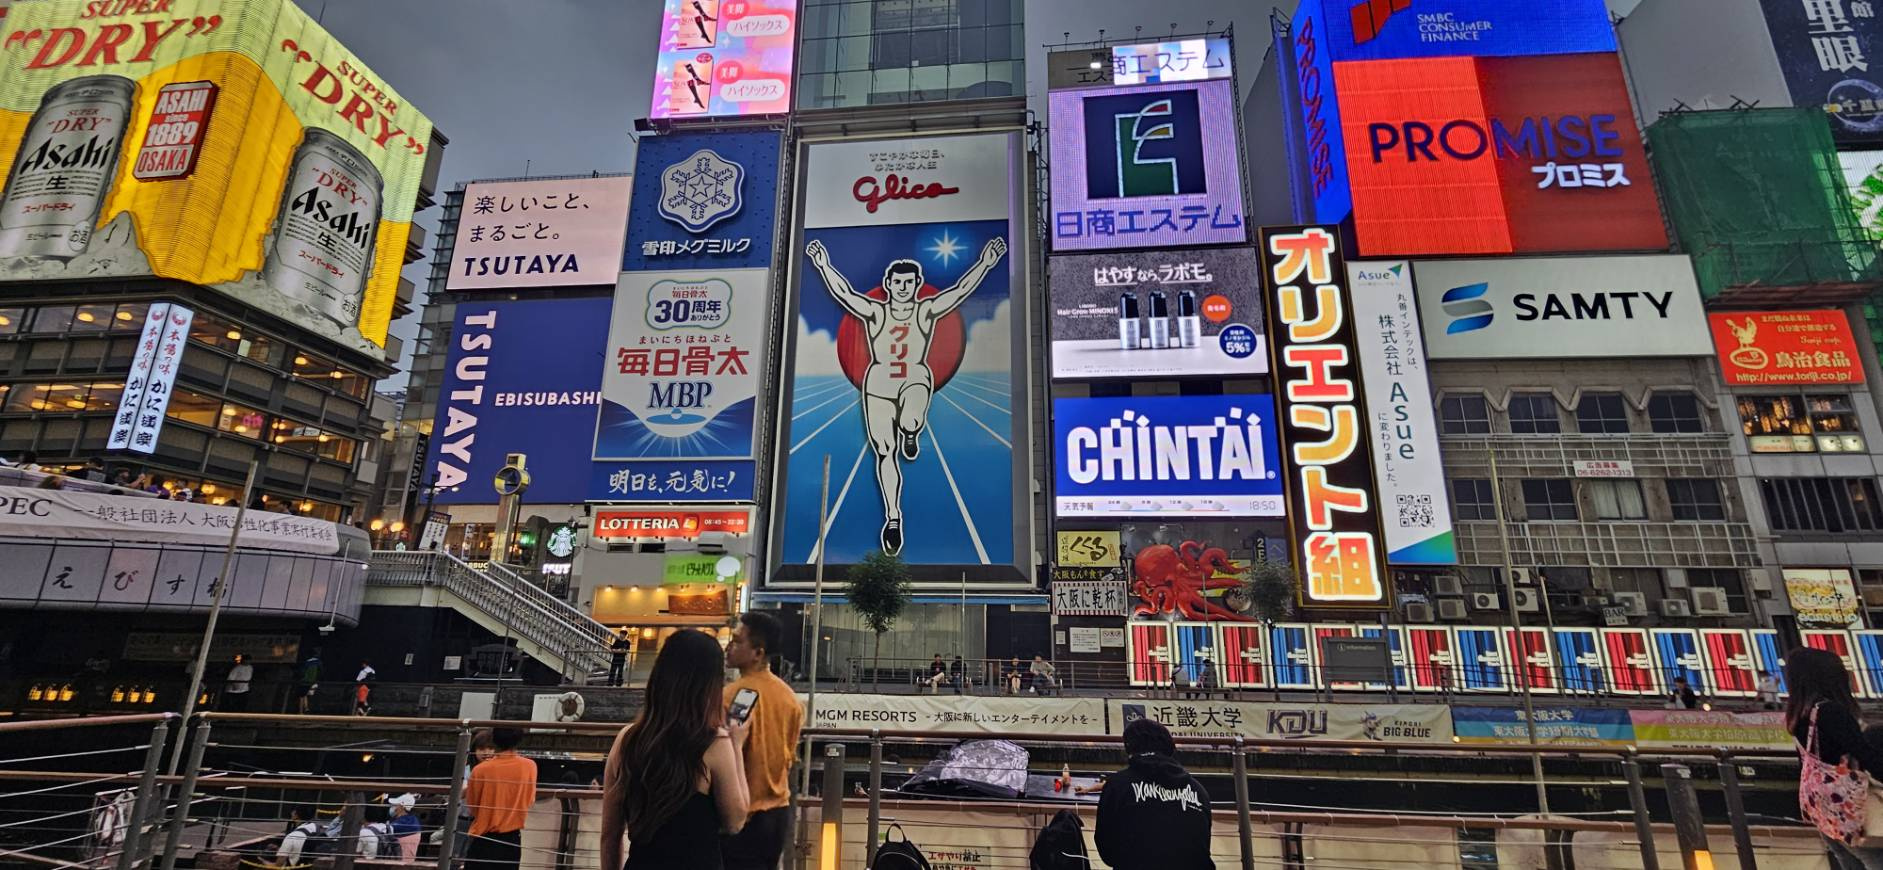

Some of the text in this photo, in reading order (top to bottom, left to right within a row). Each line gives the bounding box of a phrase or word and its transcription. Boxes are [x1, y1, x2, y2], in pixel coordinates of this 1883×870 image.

[734, 20, 783, 32] ハイソックス
[1417, 13, 1454, 24] SMBC
[1418, 21, 1493, 33] CONSUMER
[1421, 31, 1481, 42] FINANCE
[337, 60, 398, 116] SUPER
[727, 84, 778, 97] ハイソックス
[155, 87, 207, 114] ASAHI
[1297, 16, 1334, 198] PROMISE
[67, 109, 99, 117] SUPER
[165, 114, 188, 123] since
[144, 121, 197, 147] 1889
[1368, 114, 1626, 164] PROMISE
[20, 135, 114, 175] Asahi
[138, 144, 190, 172] OSAKA
[46, 175, 69, 190] 生
[329, 167, 358, 190] SUPER
[1531, 162, 1632, 189] プロミス
[473, 193, 591, 216] 楽しいこと、
[852, 174, 960, 213] Glico
[22, 202, 76, 214] スーパードライ
[291, 186, 371, 250] Asahi
[469, 222, 560, 243] まるごと。
[1056, 204, 1242, 239] 日商エステム
[316, 231, 337, 252] 生
[641, 238, 751, 256] 雪印メグミルク
[298, 250, 345, 278] スーパードライ
[464, 254, 580, 277] TSUTAYA
[1358, 270, 1391, 280] Asue
[672, 290, 708, 299] 毎日骨太
[1513, 291, 1673, 321] SAMTY
[654, 299, 722, 323] 30周年
[690, 314, 721, 322] ありがとう
[136, 326, 159, 373] 本場の味
[638, 334, 733, 345] まいにちほねぶと
[888, 322, 911, 379] グリコ
[1378, 314, 1403, 376] 株式会社
[158, 328, 181, 376] 本場の味
[617, 346, 750, 377] 毎日骨太
[434, 310, 497, 492] TSUTAYA
[494, 391, 600, 406] EBISUBASHI
[648, 382, 713, 408] MBP
[112, 377, 144, 445] かに道楽
[136, 378, 168, 448] かに道楽
[1270, 228, 1382, 600] オリエント組
[1390, 382, 1415, 460] Asue
[1377, 412, 1398, 488] に変わりました。
[408, 438, 427, 493] TSUTAYA
[1063, 502, 1094, 511] 天気予報
[600, 519, 680, 530] LOTTERIA
[1069, 536, 1108, 561] くくる
[1056, 587, 1117, 610] 大阪に乾杯
[1602, 607, 1625, 617] BAR
[815, 709, 917, 722] MGM RESORTS
[934, 711, 1089, 725] 大阪に新しいエンターテイメントを
[1153, 706, 1243, 729] 近畿大学
[1383, 726, 1431, 738] BIG BLUE
